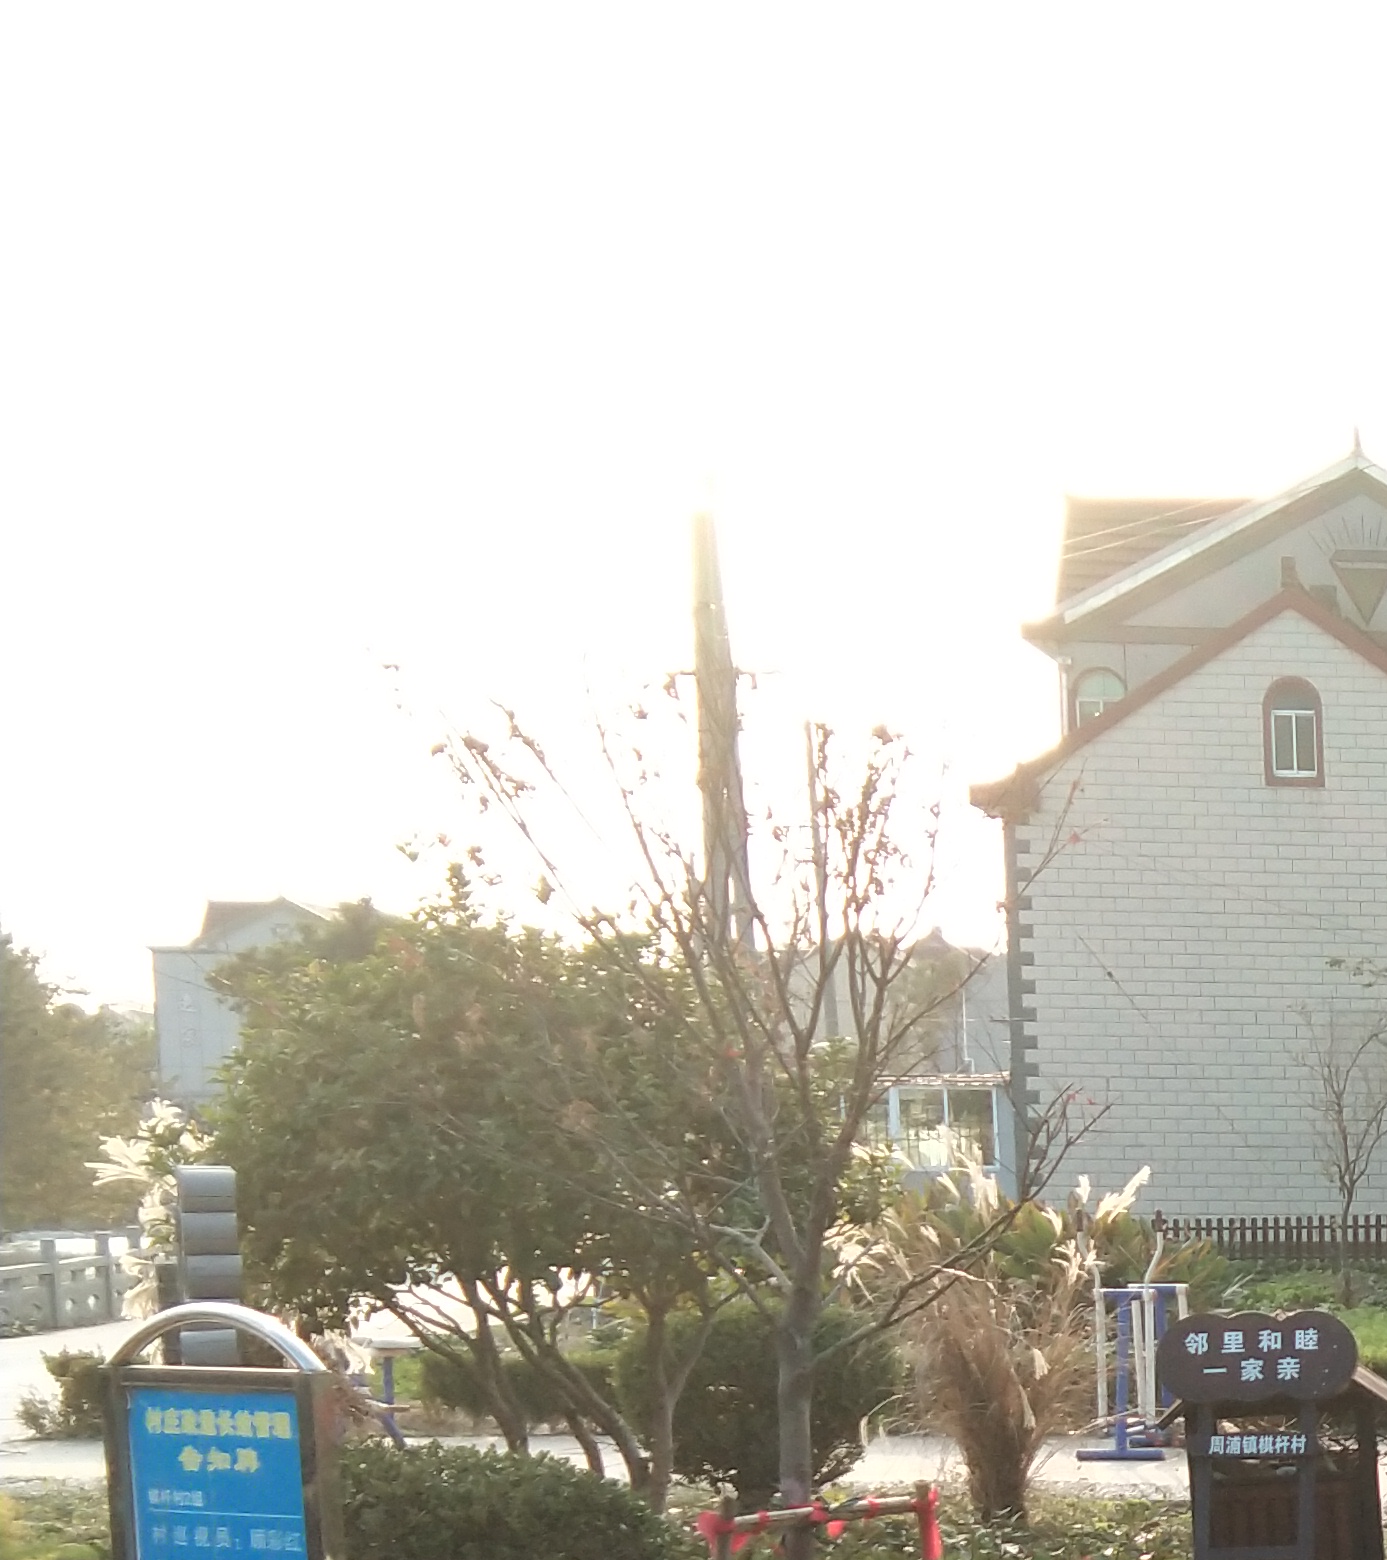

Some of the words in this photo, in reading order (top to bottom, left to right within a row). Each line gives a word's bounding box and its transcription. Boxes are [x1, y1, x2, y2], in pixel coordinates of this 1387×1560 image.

[1184, 1327, 1319, 1355] 邻里和睦
[1202, 1357, 1301, 1382] 一家亲
[1208, 1434, 1307, 1455] 周浦镇棋杆村
